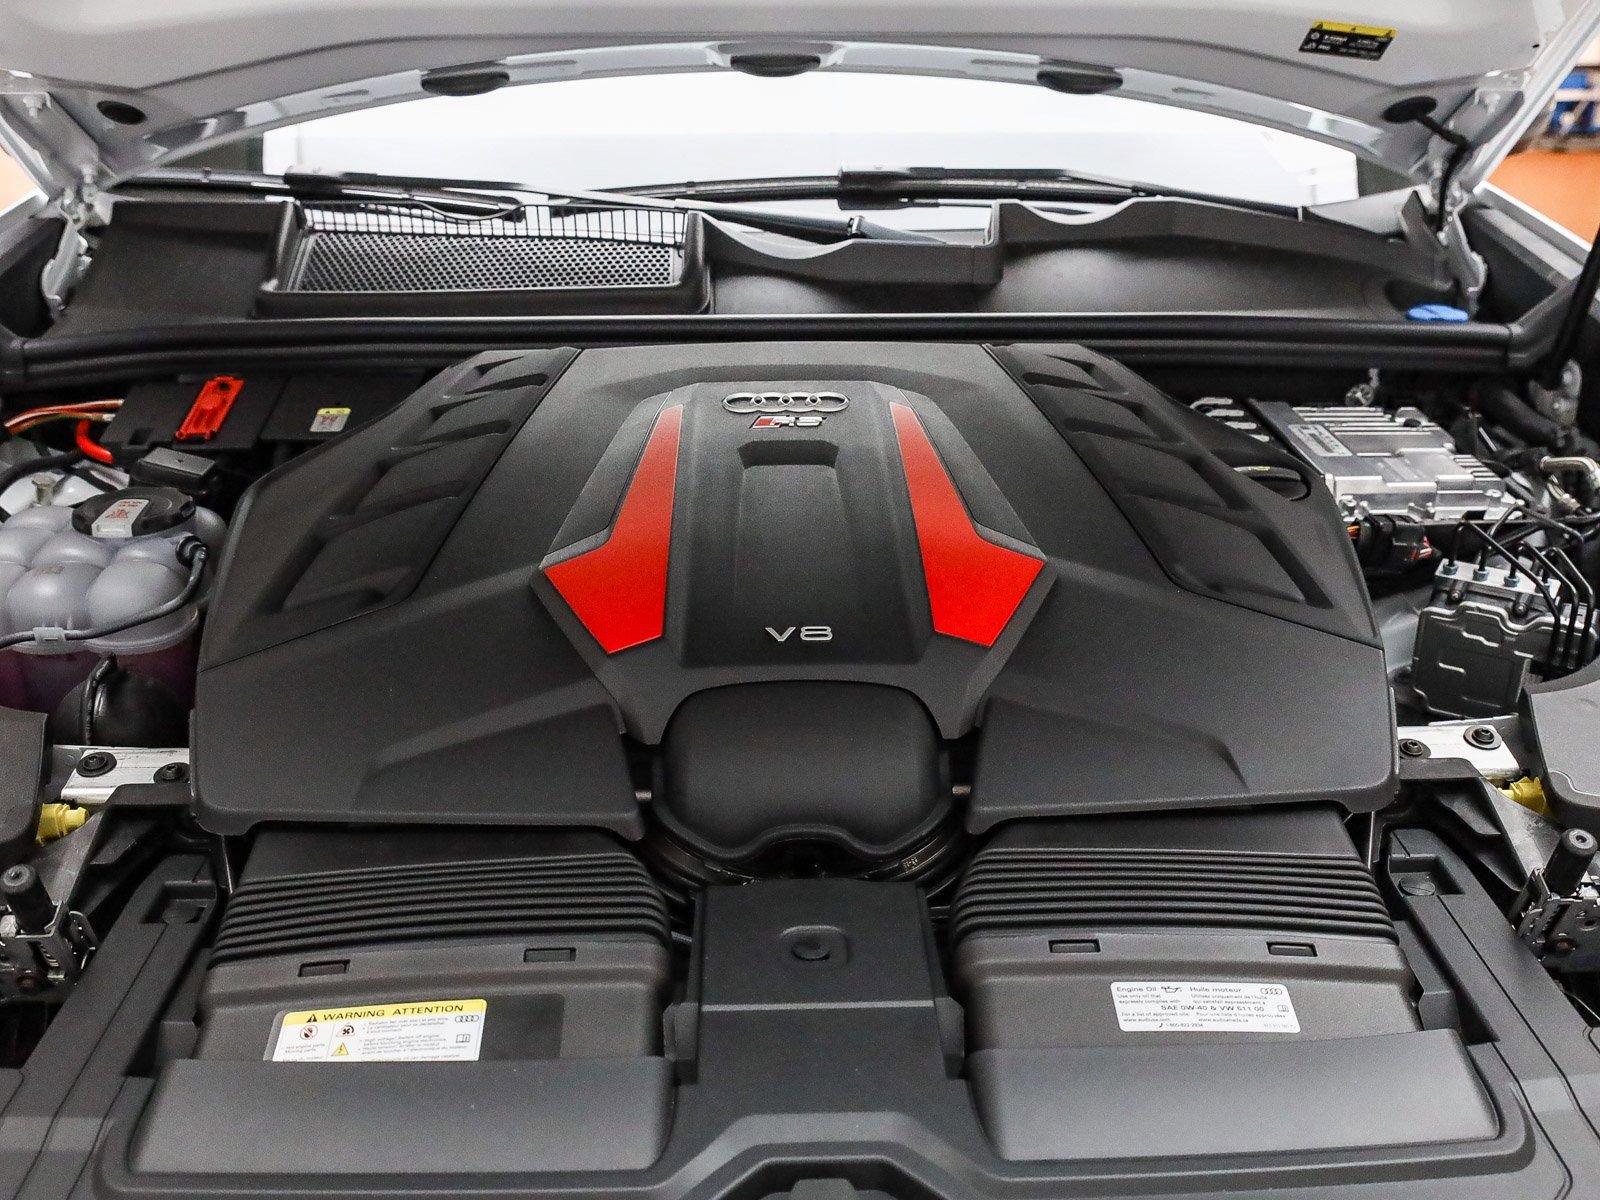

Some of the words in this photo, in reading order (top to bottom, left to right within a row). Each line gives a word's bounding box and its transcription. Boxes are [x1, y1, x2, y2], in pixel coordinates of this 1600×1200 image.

[765, 626, 833, 641] V8
[323, 1009, 385, 1021] WARNING
[392, 1005, 464, 1016] ATTENTION
